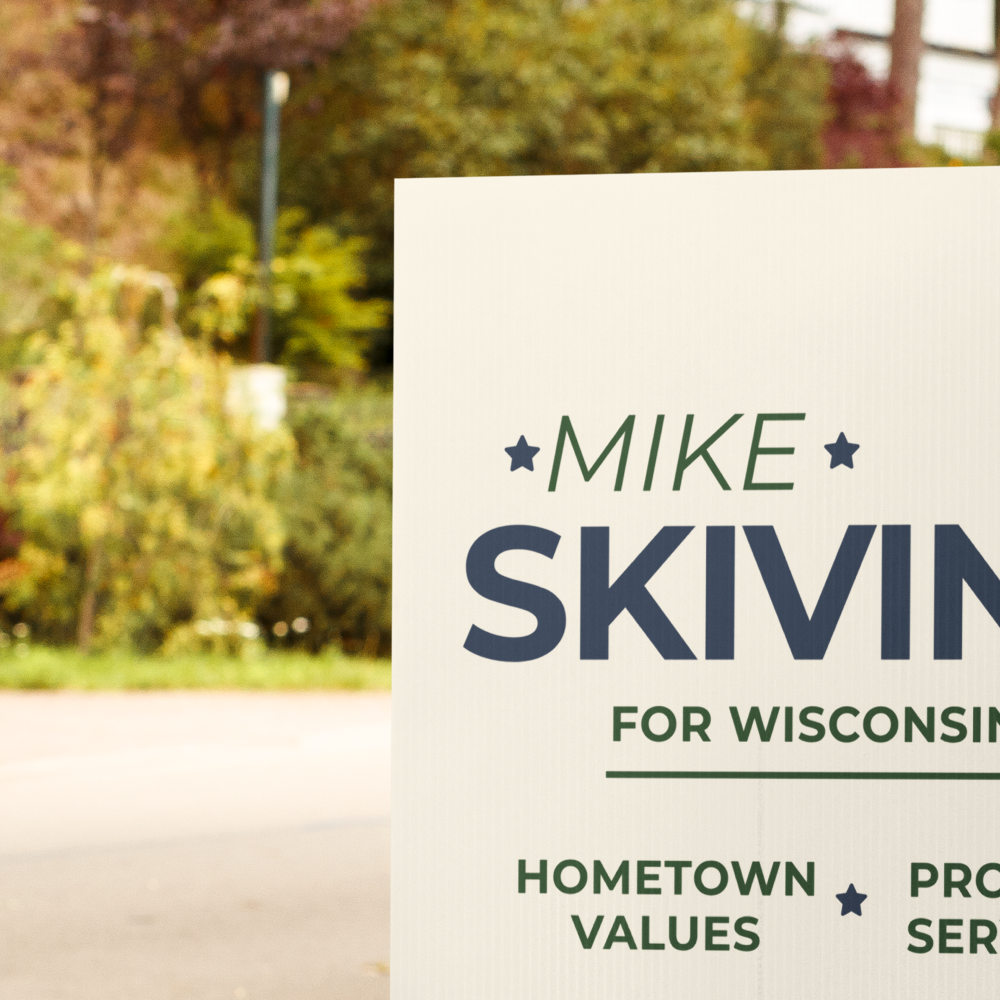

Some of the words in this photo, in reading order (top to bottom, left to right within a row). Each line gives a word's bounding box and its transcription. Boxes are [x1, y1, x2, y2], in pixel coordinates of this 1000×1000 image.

[548, 412, 807, 492] MIKE
[612, 705, 712, 743] FOR
[517, 859, 815, 897] HOMETOWN
[571, 914, 761, 952] VALUES
